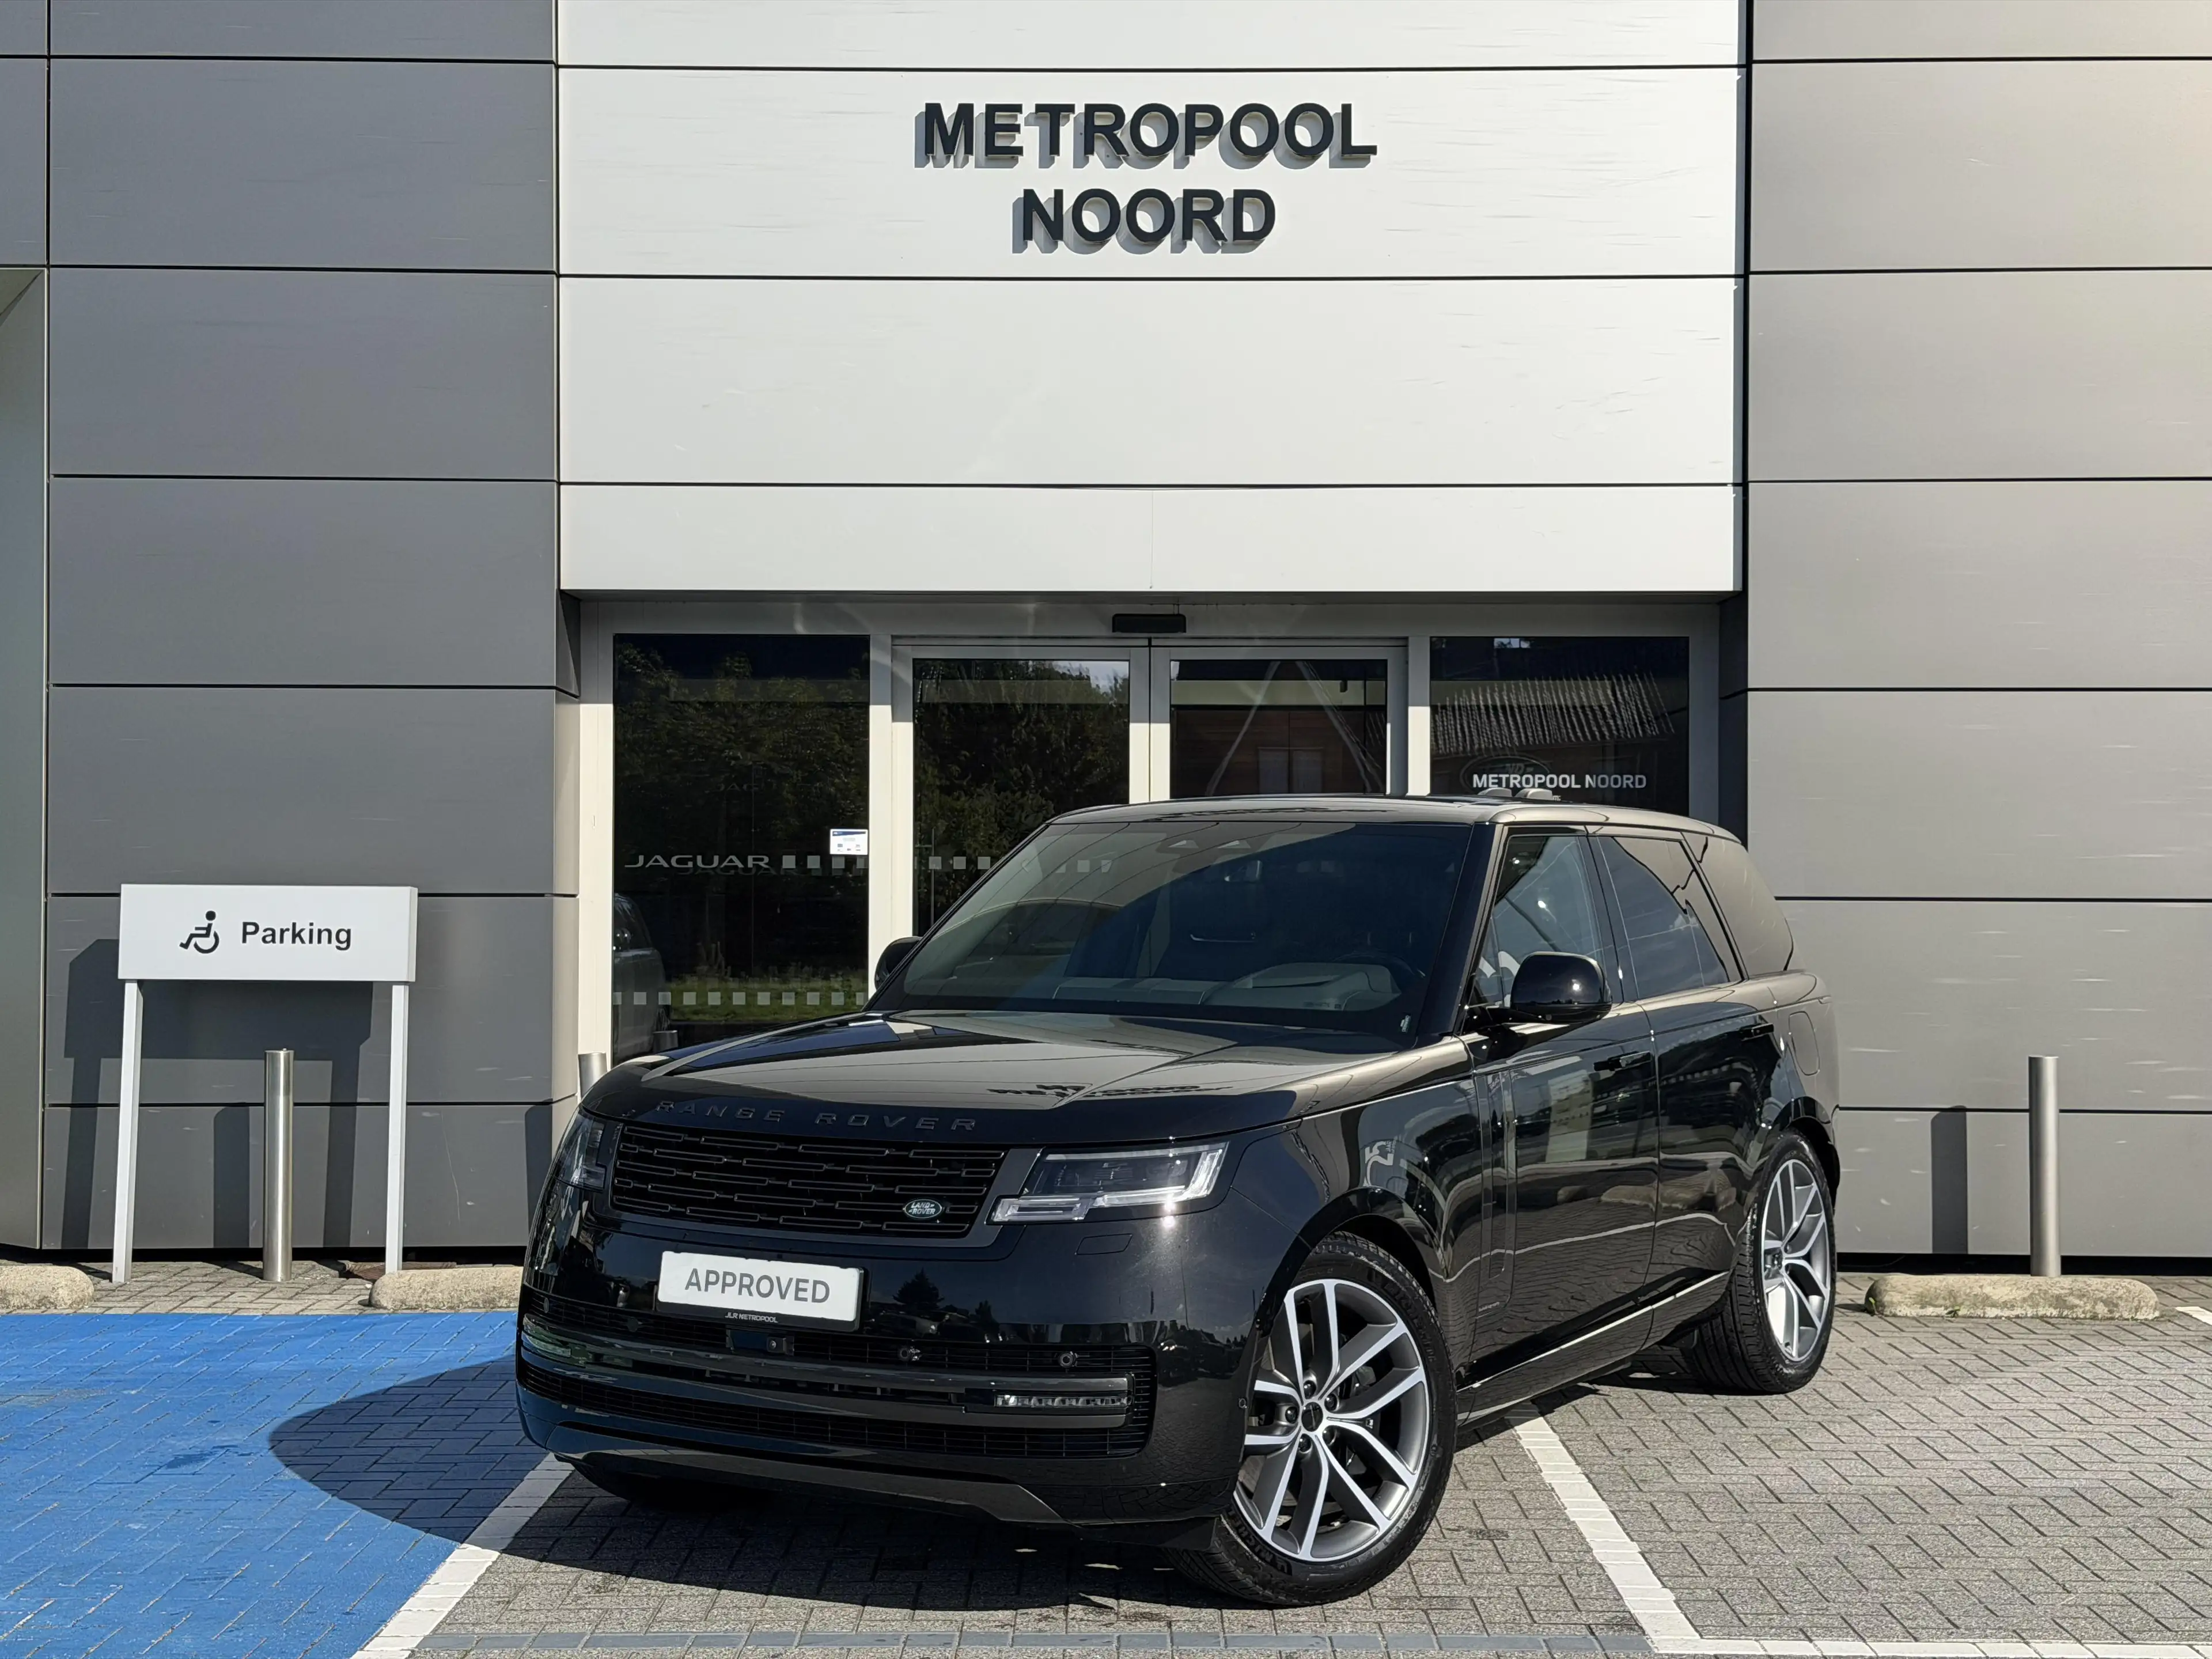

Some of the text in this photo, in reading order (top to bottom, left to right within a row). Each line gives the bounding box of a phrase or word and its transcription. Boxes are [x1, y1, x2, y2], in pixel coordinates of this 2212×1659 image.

[925, 103, 1378, 157] METROPOOL
[1022, 188, 1277, 242] NOORD
[1472, 774, 1647, 789] METROPOOL NOORD
[624, 855, 771, 869] JAGUAR
[241, 921, 352, 951] Parking
[654, 1100, 976, 1131] RANGE ROVER
[684, 1268, 830, 1304] APPROVED
